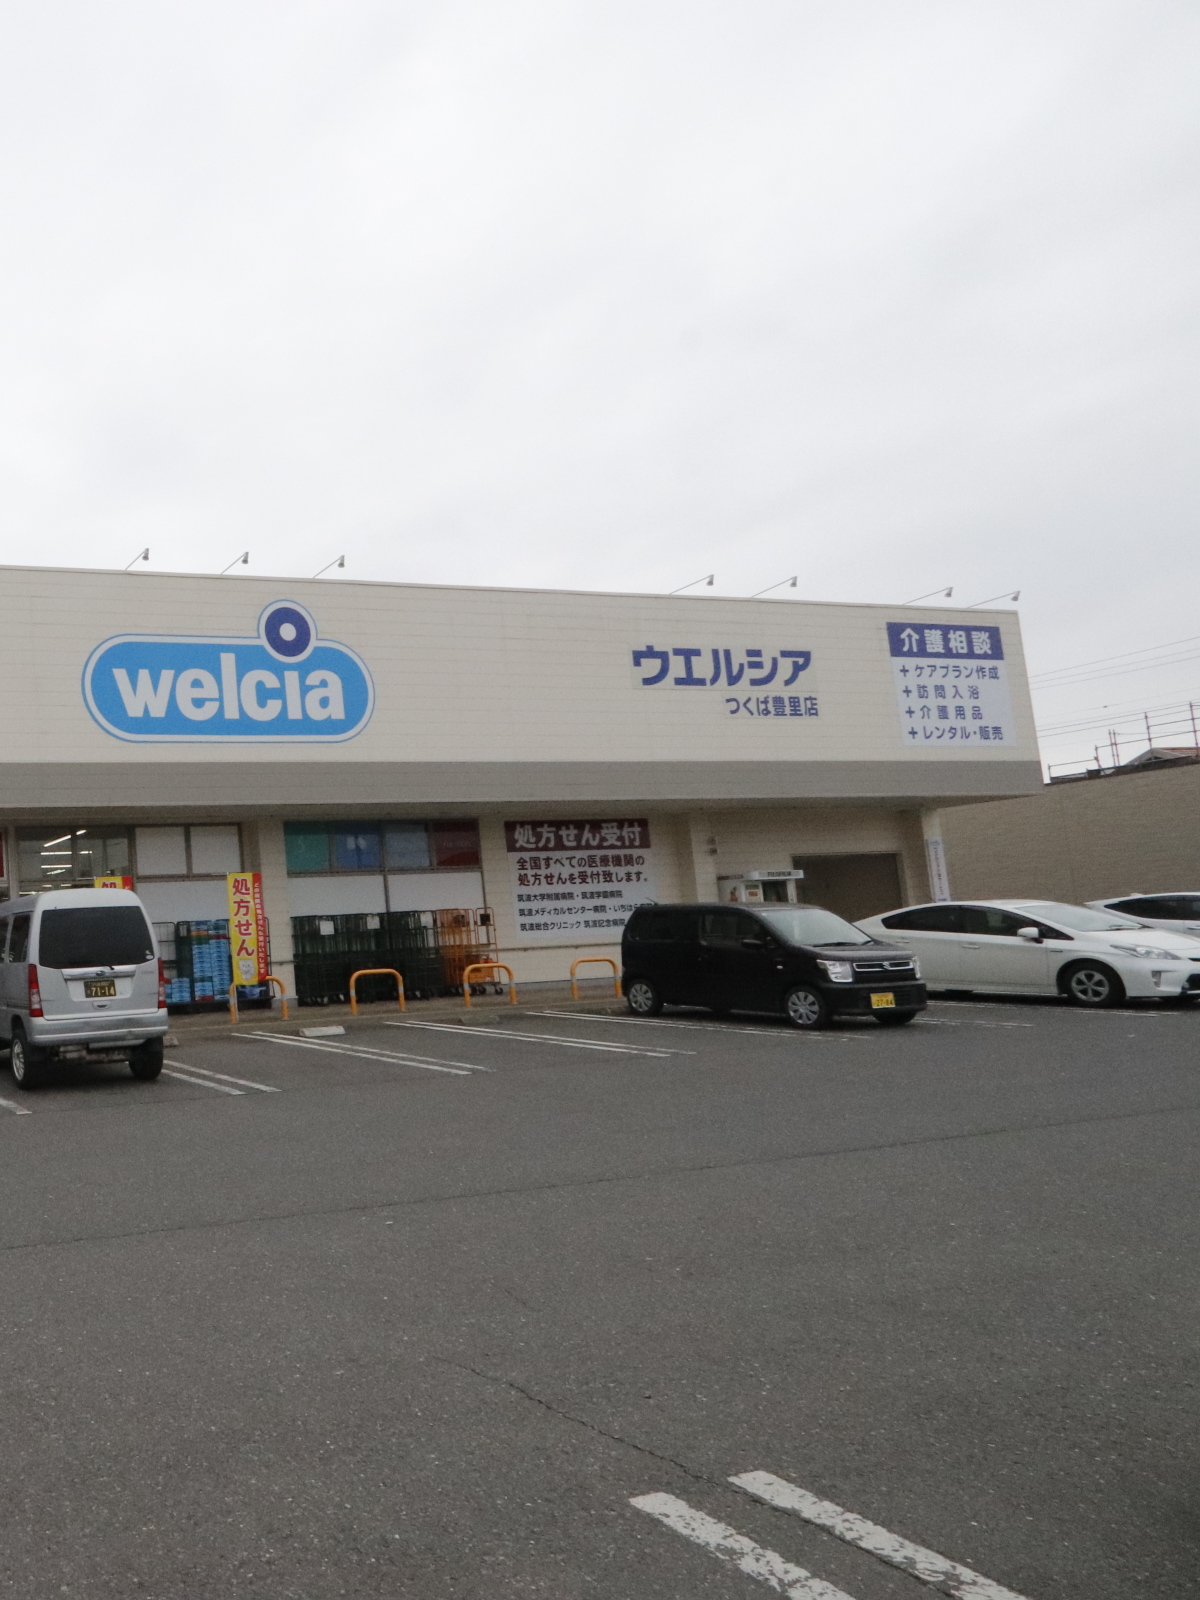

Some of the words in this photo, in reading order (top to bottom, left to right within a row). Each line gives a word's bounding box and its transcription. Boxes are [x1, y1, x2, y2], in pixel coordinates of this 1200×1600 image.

[900, 628, 992, 655] 介護相談
[112, 607, 346, 722] welcia
[632, 645, 812, 687] ウエルシア
[914, 664, 1000, 680] ケアプラン作成
[917, 684, 980, 699] 訪問入浴
[725, 695, 819, 717] つくば豊里店
[920, 705, 983, 720] 介護用品
[923, 726, 1004, 741] レンタル・販売
[514, 823, 641, 849] 処方せん受付
[517, 854, 645, 871] 全国すべての医療機関の
[518, 870, 648, 887] 処方せんを受付致します。
[232, 878, 255, 957] 処方せん
